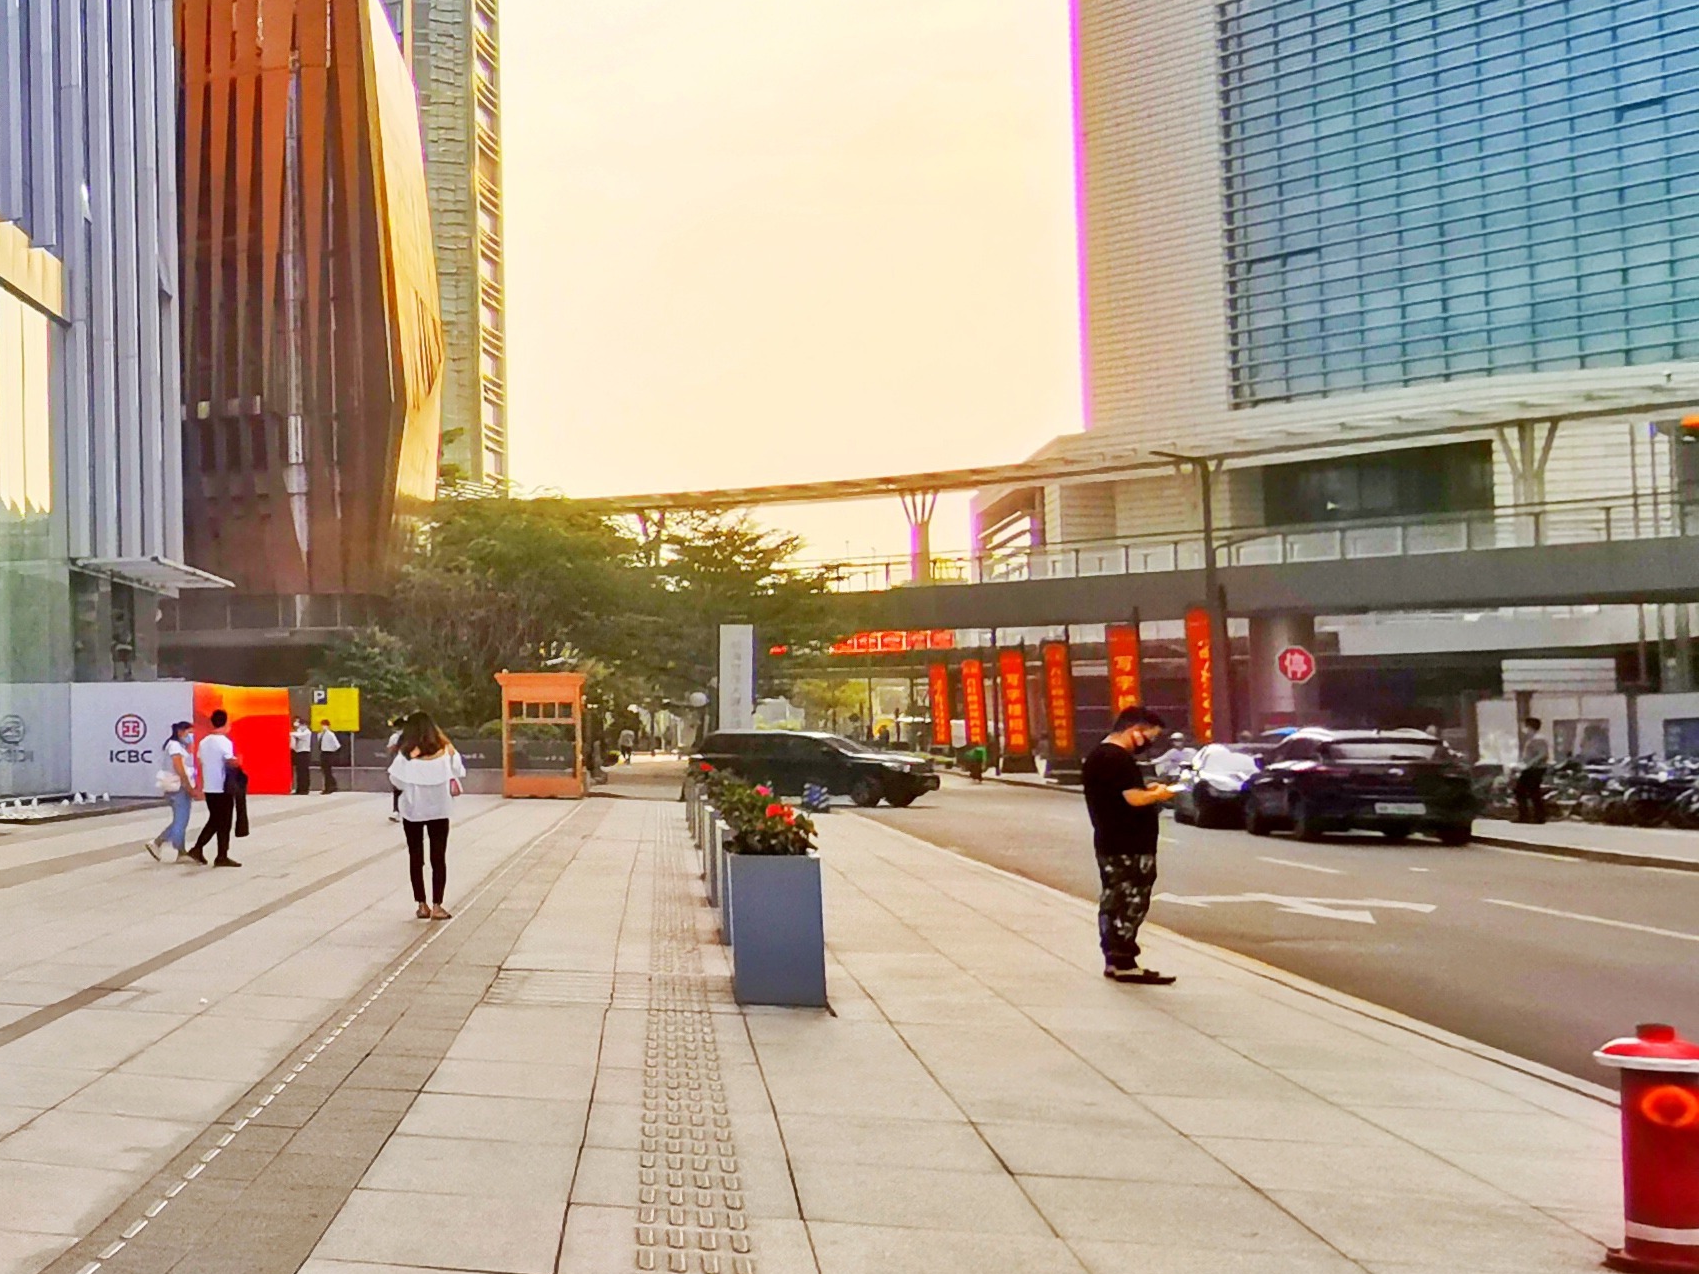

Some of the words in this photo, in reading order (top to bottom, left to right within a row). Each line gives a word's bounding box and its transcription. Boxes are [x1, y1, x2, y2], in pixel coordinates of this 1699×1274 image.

[1283, 651, 1308, 680] 停
[313, 689, 325, 704] P
[109, 749, 154, 764] ICBC
